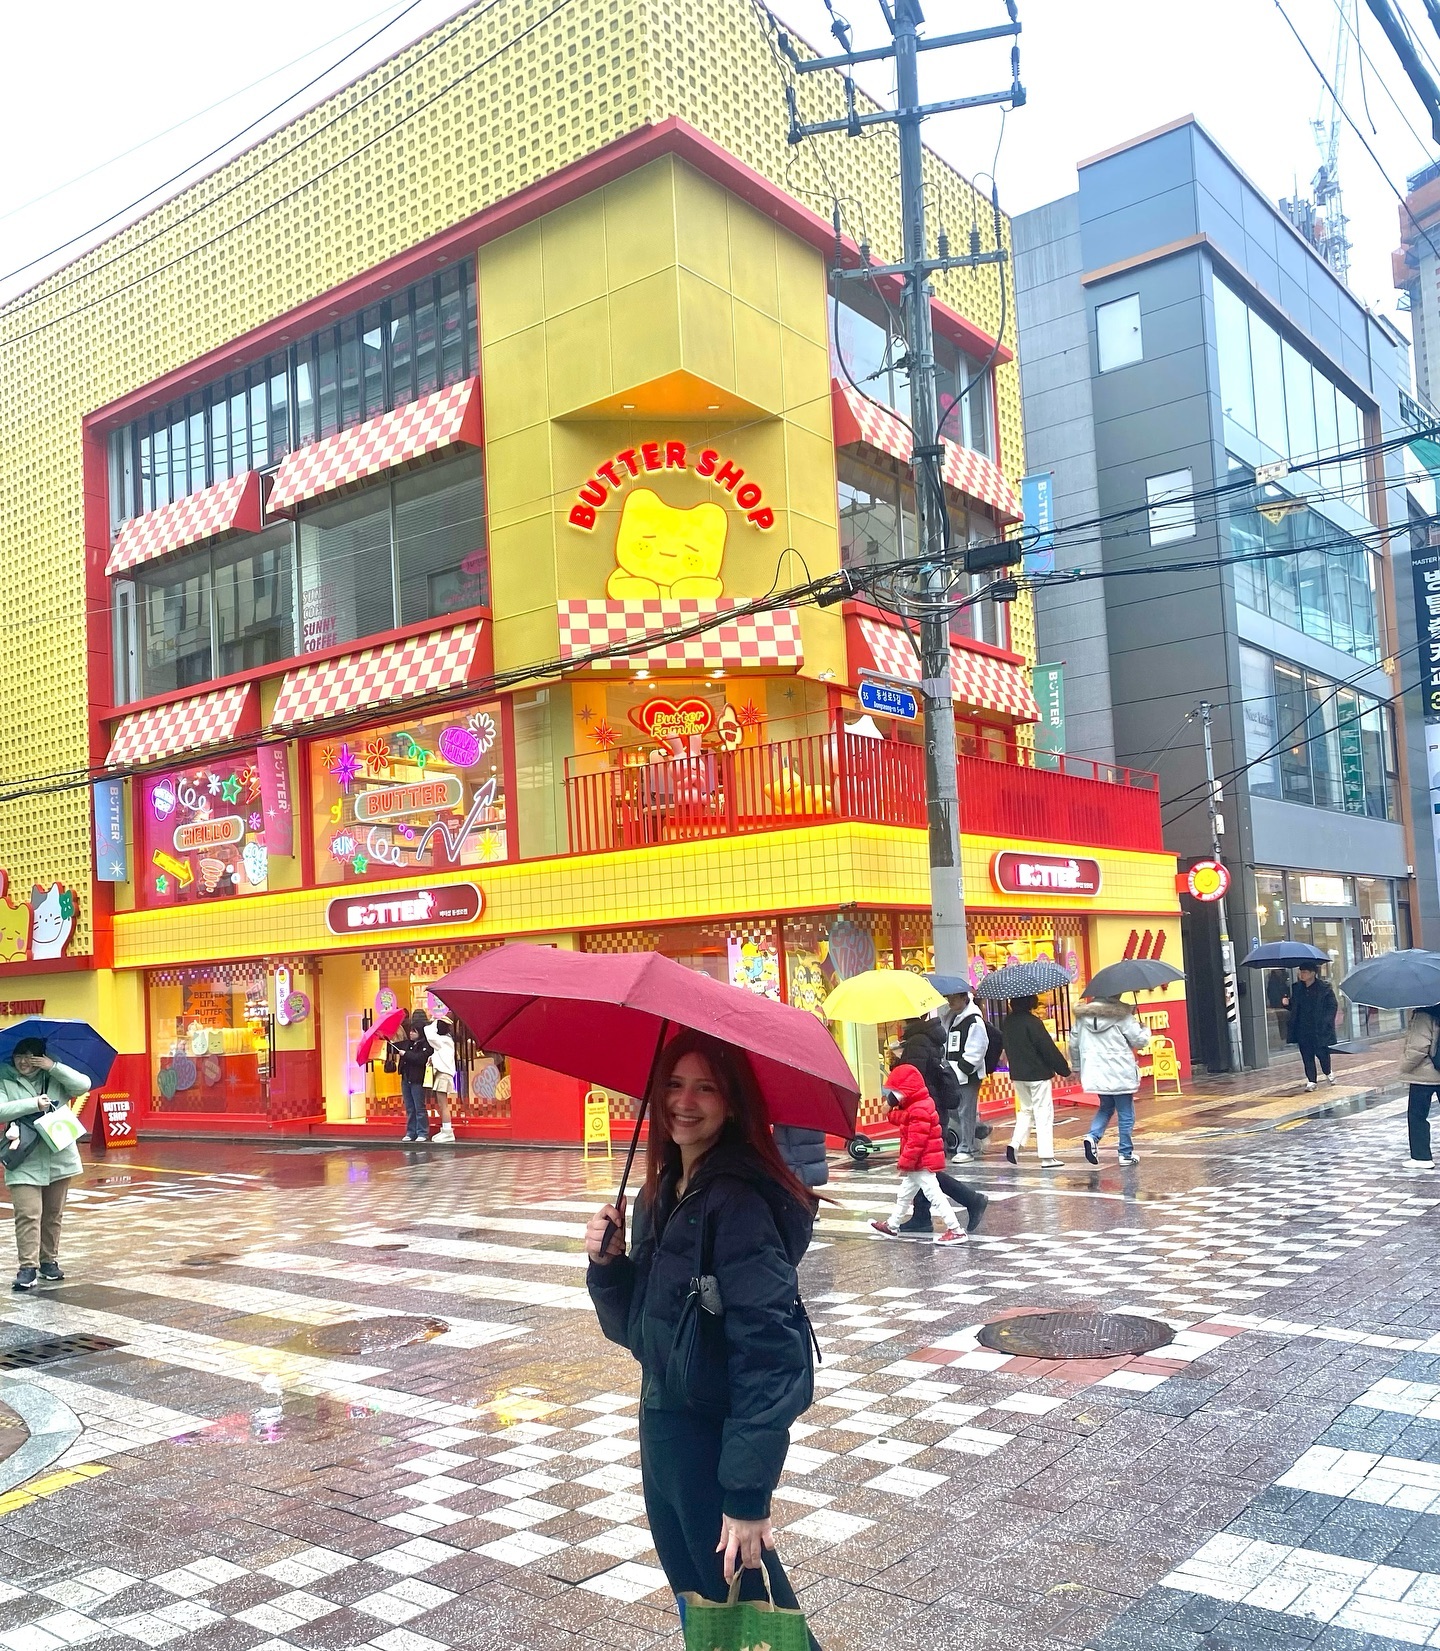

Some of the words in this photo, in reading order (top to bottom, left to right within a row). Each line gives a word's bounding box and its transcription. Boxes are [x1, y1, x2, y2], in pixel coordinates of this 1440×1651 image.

[568, 441, 687, 530] BUTTER
[694, 449, 775, 530] SHOP
[1412, 556, 1437, 566] MASTER
[303, 615, 336, 638] SUNNY
[304, 632, 337, 653] COFFEE
[1048, 671, 1060, 727] BUTTER
[654, 711, 704, 724] Butter
[651, 722, 705, 737] Family
[273, 750, 288, 810] BUTTER
[367, 783, 448, 816] BUTTER
[109, 786, 121, 841] BUTTER
[182, 821, 233, 847] HELLO
[332, 836, 354, 856] FUN
[347, 896, 432, 928] BUTTER
[421, 966, 438, 976] ME
[193, 991, 225, 999] BETTER
[10, 999, 46, 1015] SUNNY
[194, 1008, 223, 1016] BUTTER
[103, 1101, 131, 1112] BUTTER
[108, 1111, 128, 1122] SHOP
